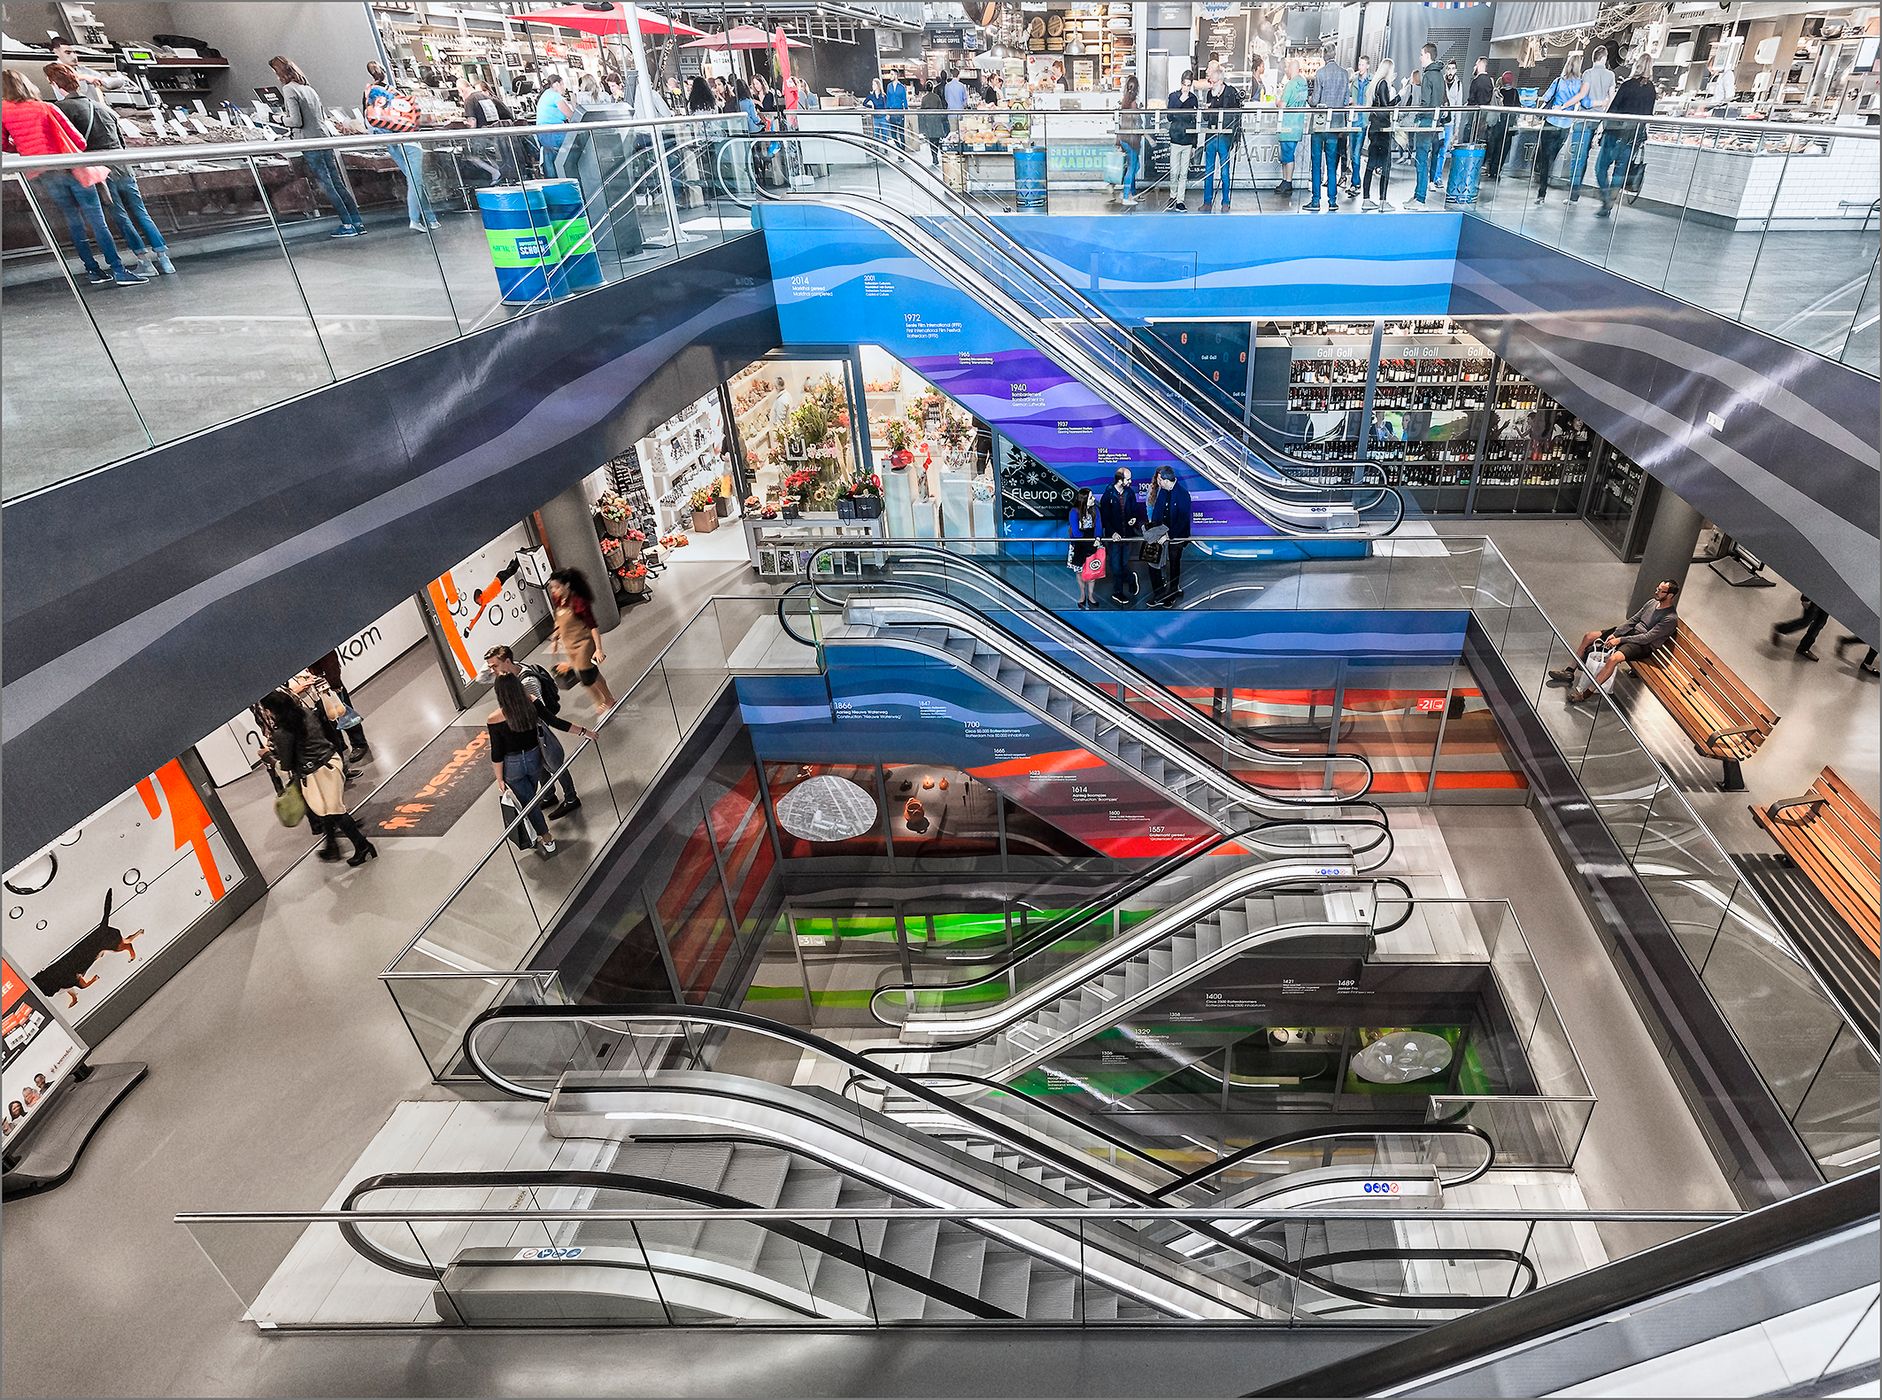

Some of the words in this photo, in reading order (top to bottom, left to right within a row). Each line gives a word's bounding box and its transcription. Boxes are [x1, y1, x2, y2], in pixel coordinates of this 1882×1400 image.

[791, 276, 810, 285] 2014
[904, 313, 921, 322] 1972
[1317, 348, 1333, 358] Gall
[1336, 348, 1353, 358] Gall
[1402, 347, 1419, 357] Gall
[1422, 347, 1439, 357] Gall
[1467, 346, 1484, 357] Gall
[1010, 383, 1027, 392] 1940
[1011, 487, 1058, 503] Fleurop
[834, 702, 853, 710] 1866
[414, 730, 491, 799] vendor
[1338, 979, 1355, 987] 1489
